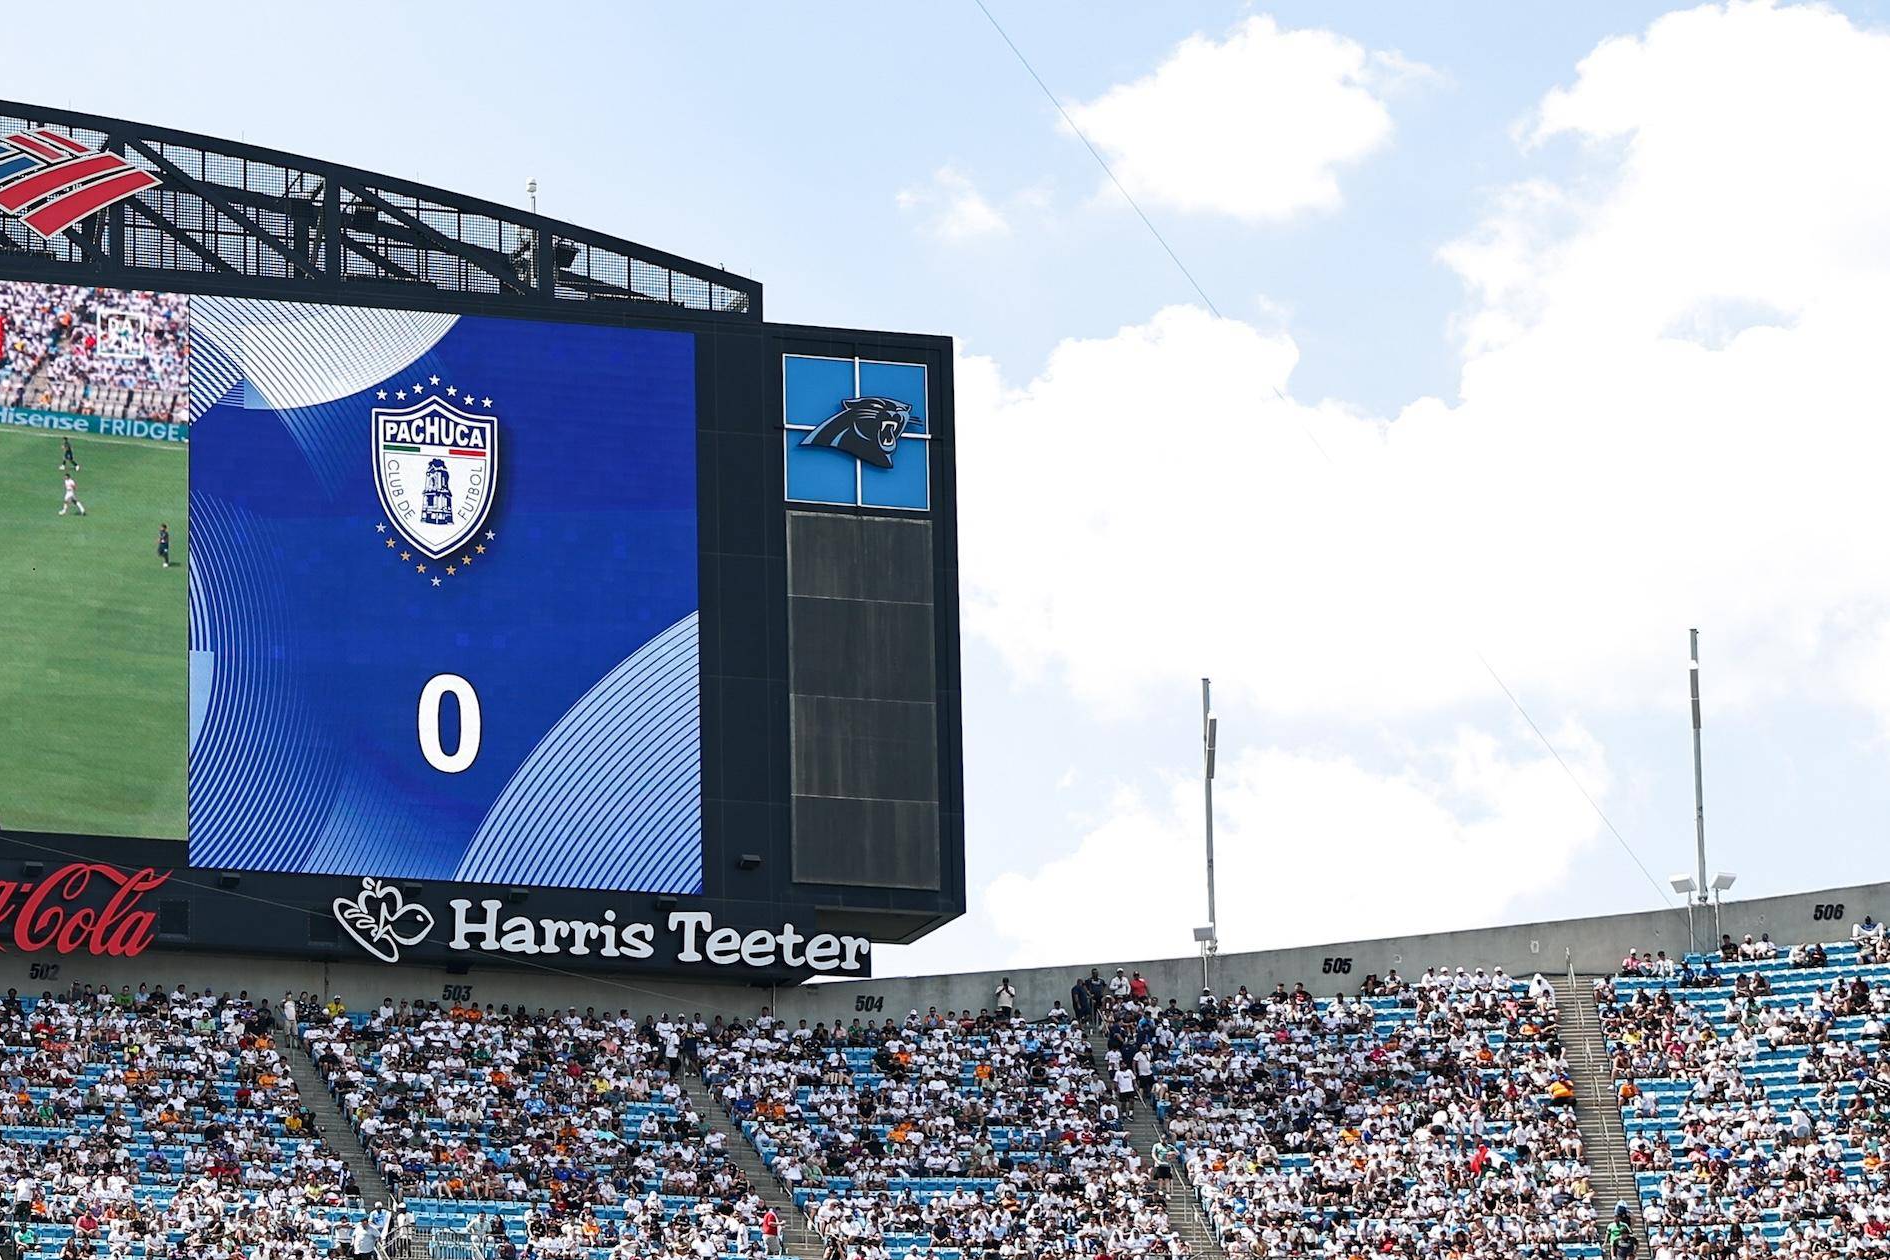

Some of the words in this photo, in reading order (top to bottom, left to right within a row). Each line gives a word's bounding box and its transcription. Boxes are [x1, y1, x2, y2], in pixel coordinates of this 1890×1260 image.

[385, 416, 485, 448] PACHUCA
[388, 459, 405, 498] CLUB
[398, 499, 416, 521] DE
[457, 465, 483, 521] FUTBOL
[418, 672, 482, 773] 0
[1813, 904, 1845, 921] 506
[449, 898, 656, 961] Harris
[668, 910, 871, 972] Teeter
[29, 963, 60, 981] 502
[1323, 957, 1353, 974] 505
[442, 982, 473, 1002] 503
[855, 994, 884, 1013] 504
